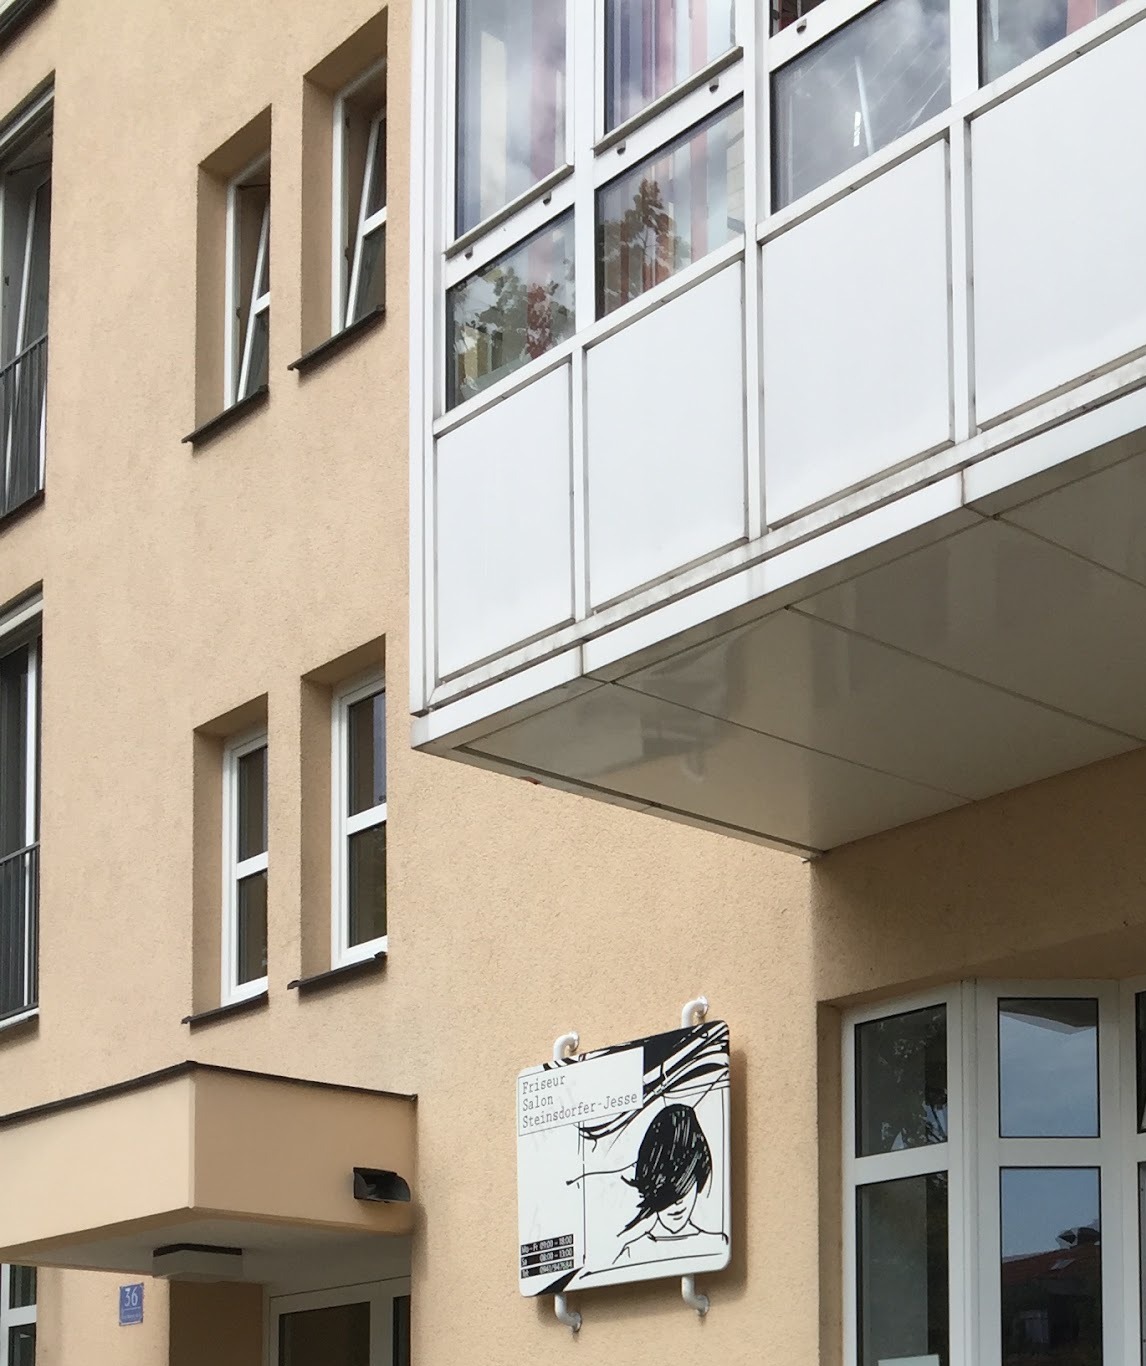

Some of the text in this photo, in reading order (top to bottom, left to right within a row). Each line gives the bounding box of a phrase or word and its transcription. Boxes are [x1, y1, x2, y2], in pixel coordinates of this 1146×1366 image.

[522, 1075, 566, 1095] Friseur
[522, 1095, 554, 1112] Salon
[522, 1093, 639, 1129] Steinsdorfer-Jesse
[124, 1286, 139, 1307] 36
